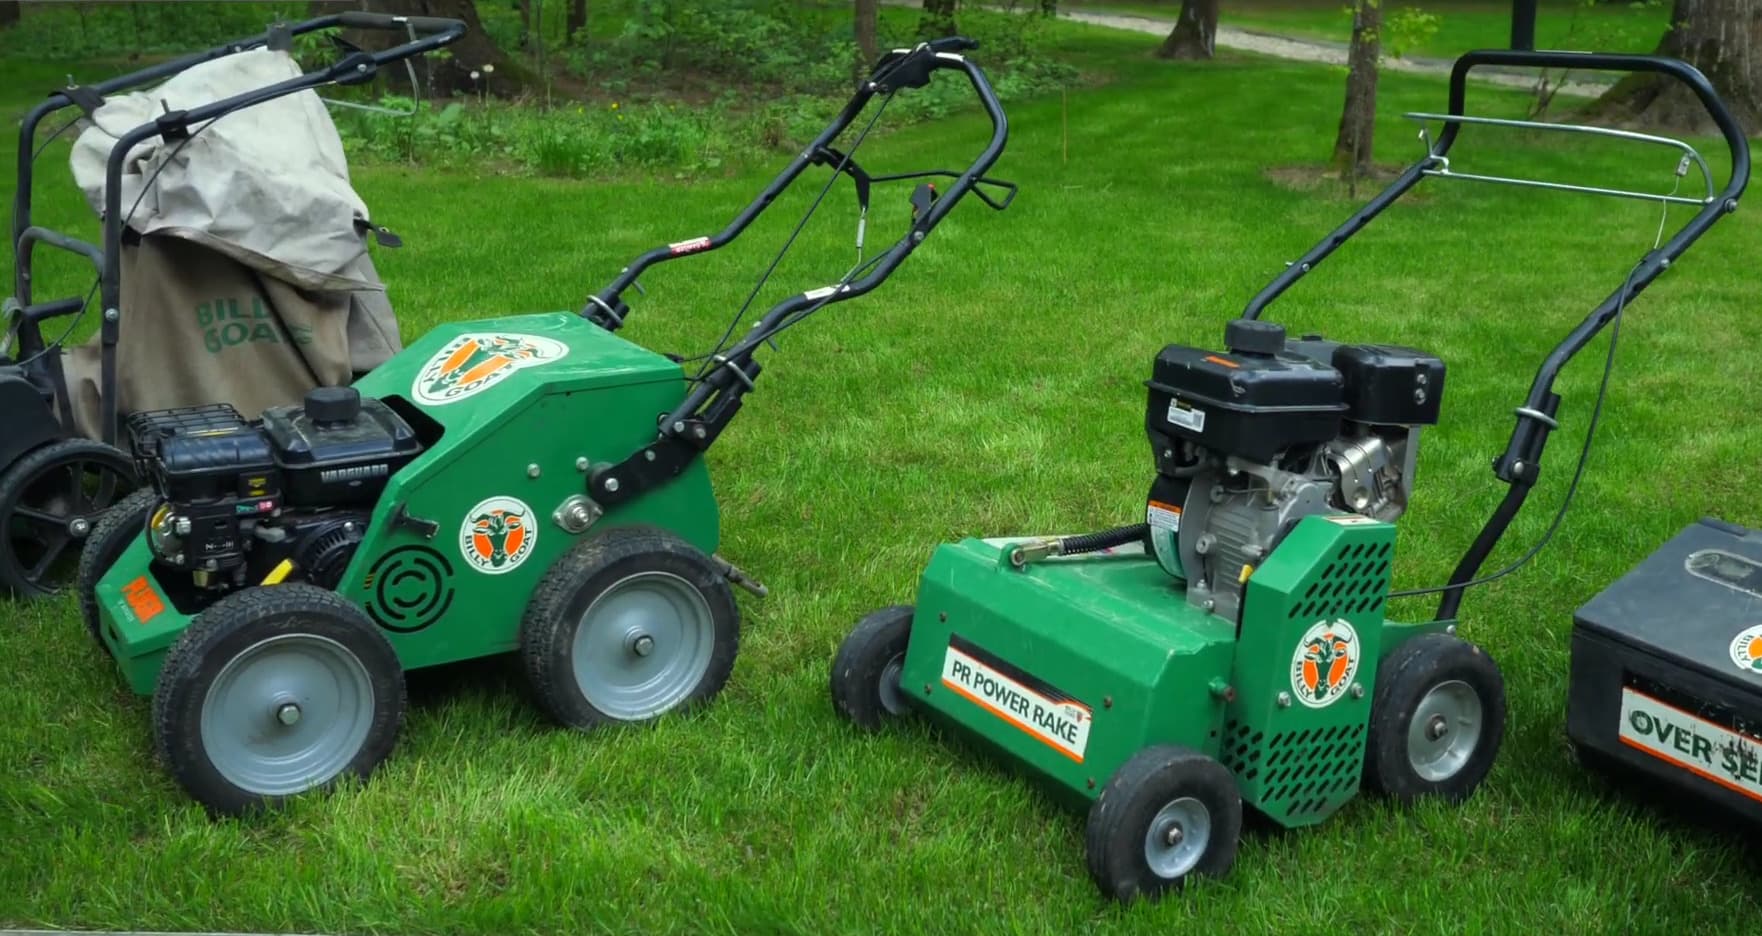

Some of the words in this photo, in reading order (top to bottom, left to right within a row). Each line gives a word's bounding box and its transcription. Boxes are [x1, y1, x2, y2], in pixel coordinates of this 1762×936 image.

[195, 296, 274, 329] BILL
[423, 337, 472, 383] BILLY
[320, 463, 389, 483] VANGUARD
[464, 535, 489, 566] BILLY
[510, 527, 532, 563] GOAT
[1737, 634, 1755, 662] BILLY
[1295, 660, 1313, 698] BILLY
[1330, 656, 1354, 696] GOAT
[951, 660, 972, 685] PR
[973, 671, 1031, 719] POWER
[1032, 704, 1078, 745] RAKE
[1630, 709, 1713, 765] OVER
